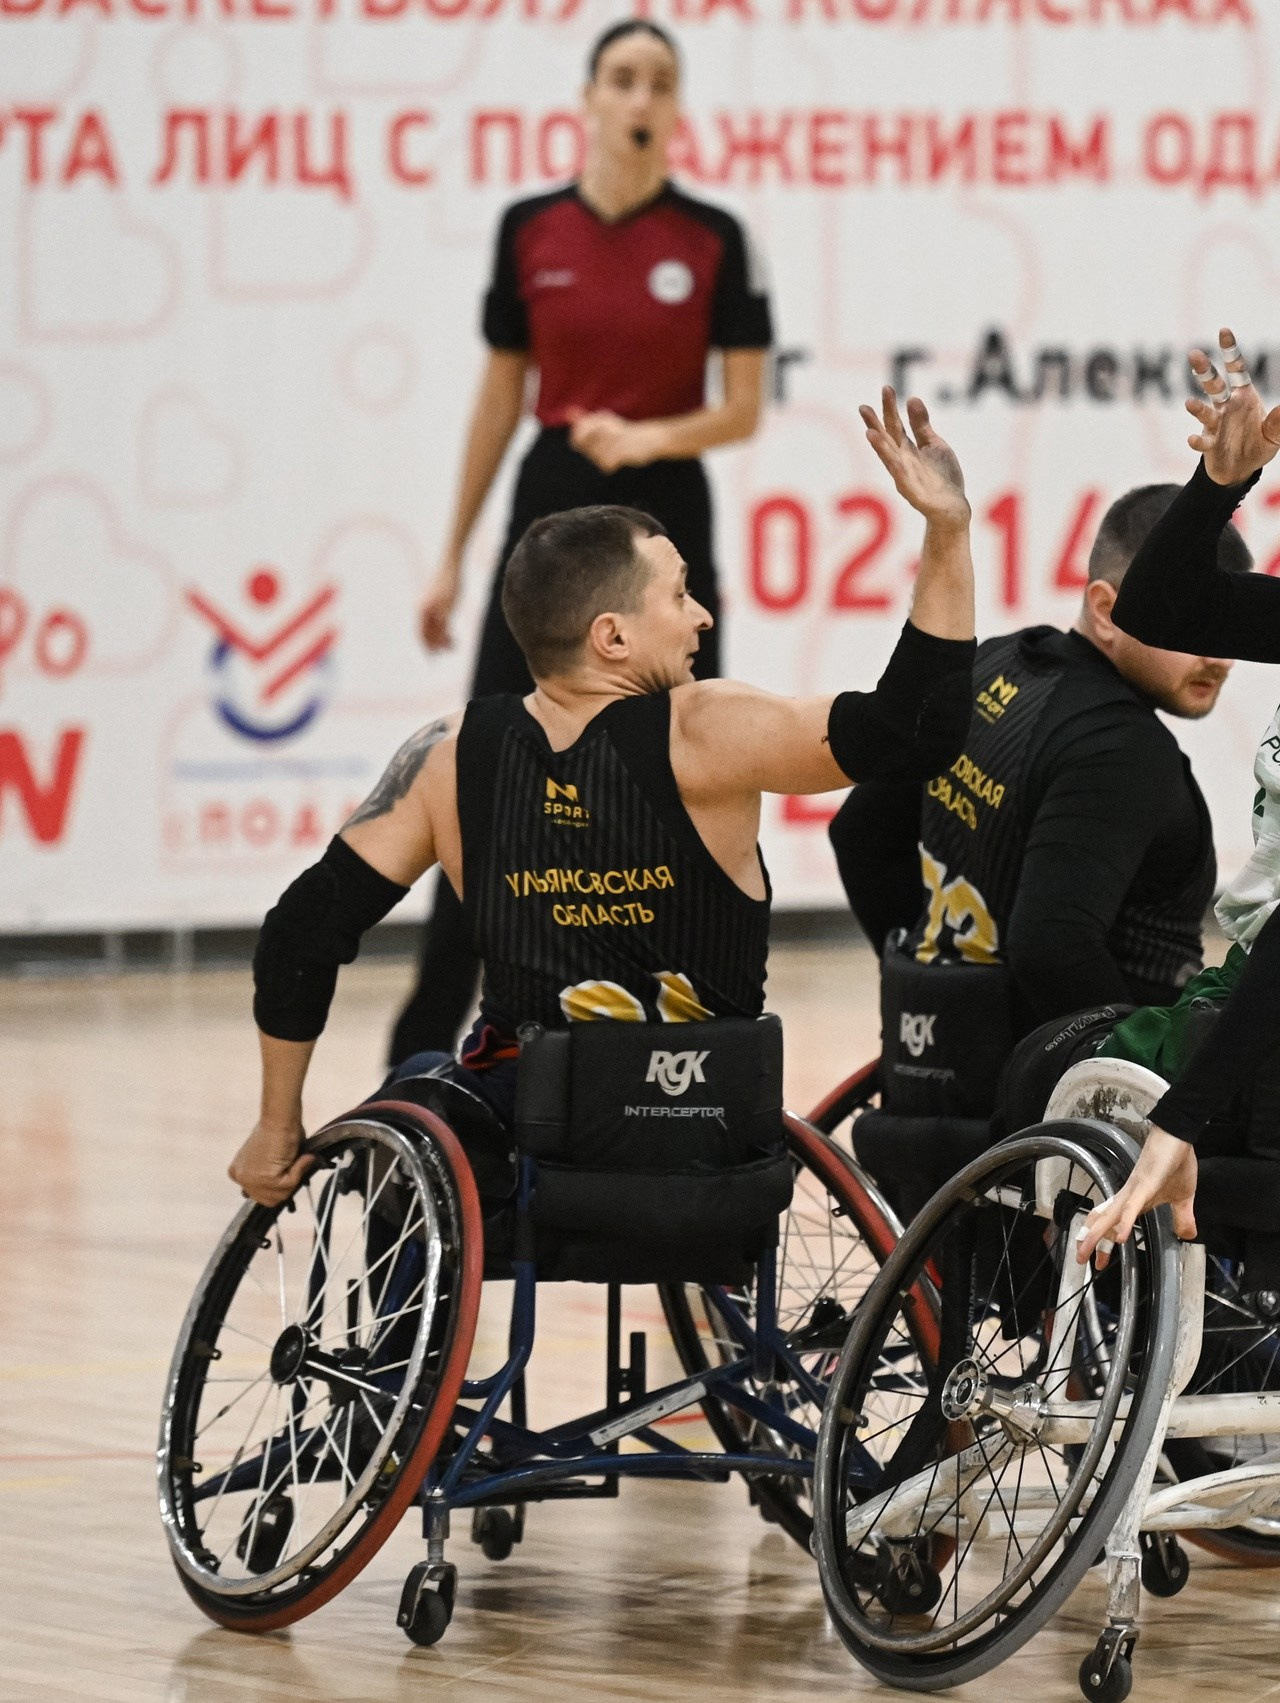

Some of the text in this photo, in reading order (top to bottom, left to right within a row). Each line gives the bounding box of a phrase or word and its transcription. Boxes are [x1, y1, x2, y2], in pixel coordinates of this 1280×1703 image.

[0, 106, 122, 188] ТА
[149, 106, 355, 206] ЛИЦ
[386, 108, 434, 188] С
[470, 106, 1110, 188] ПОАЖЕНИЕМ
[505, 864, 675, 898] УЛЬЯНОВСКАЯ
[552, 902, 656, 928] ОБЛАСТЬ
[624, 1105, 726, 1118] INTERCEPTOR
